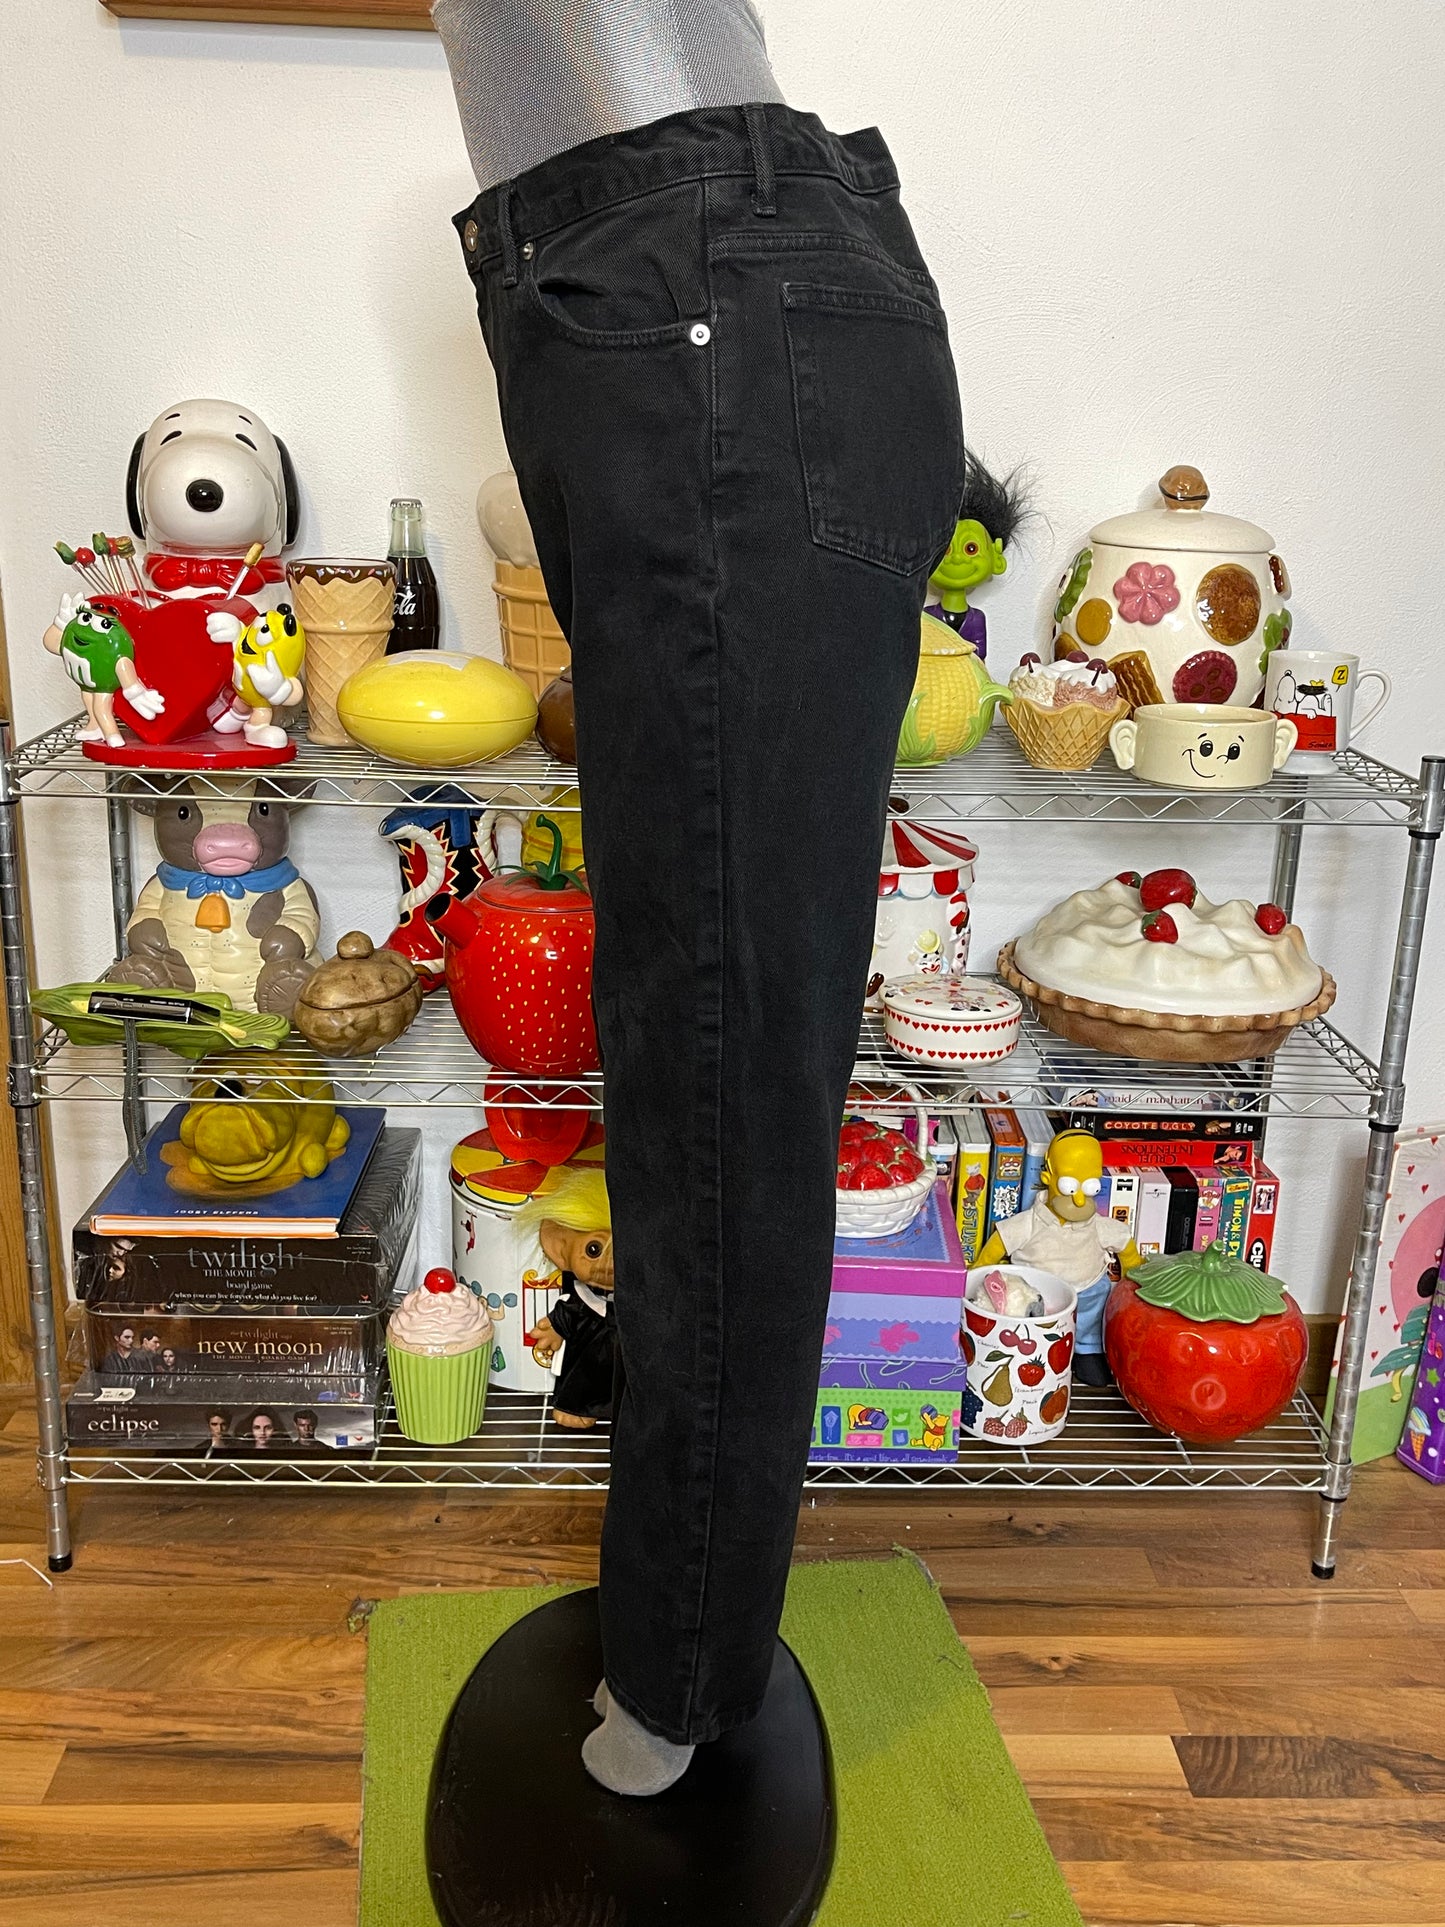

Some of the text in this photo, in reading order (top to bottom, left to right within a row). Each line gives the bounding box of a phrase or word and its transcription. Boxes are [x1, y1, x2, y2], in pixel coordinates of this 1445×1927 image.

[393, 585, 417, 615] ola
[1337, 669, 1345, 680] Z
[1146, 1095, 1204, 1105] manhattn
[1104, 1121, 1196, 1131] COYOTE UGLY
[1121, 1143, 1194, 1154] INTENTIONS
[1138, 1154, 1178, 1165] CRUEL
[187, 1239, 309, 1277] twilight
[203, 1268, 257, 1278] THE MOVIE
[226, 1280, 273, 1291] board game
[239, 1327, 279, 1341] twilight
[197, 1340, 324, 1356] new moon
[88, 1413, 160, 1439] eclipse
